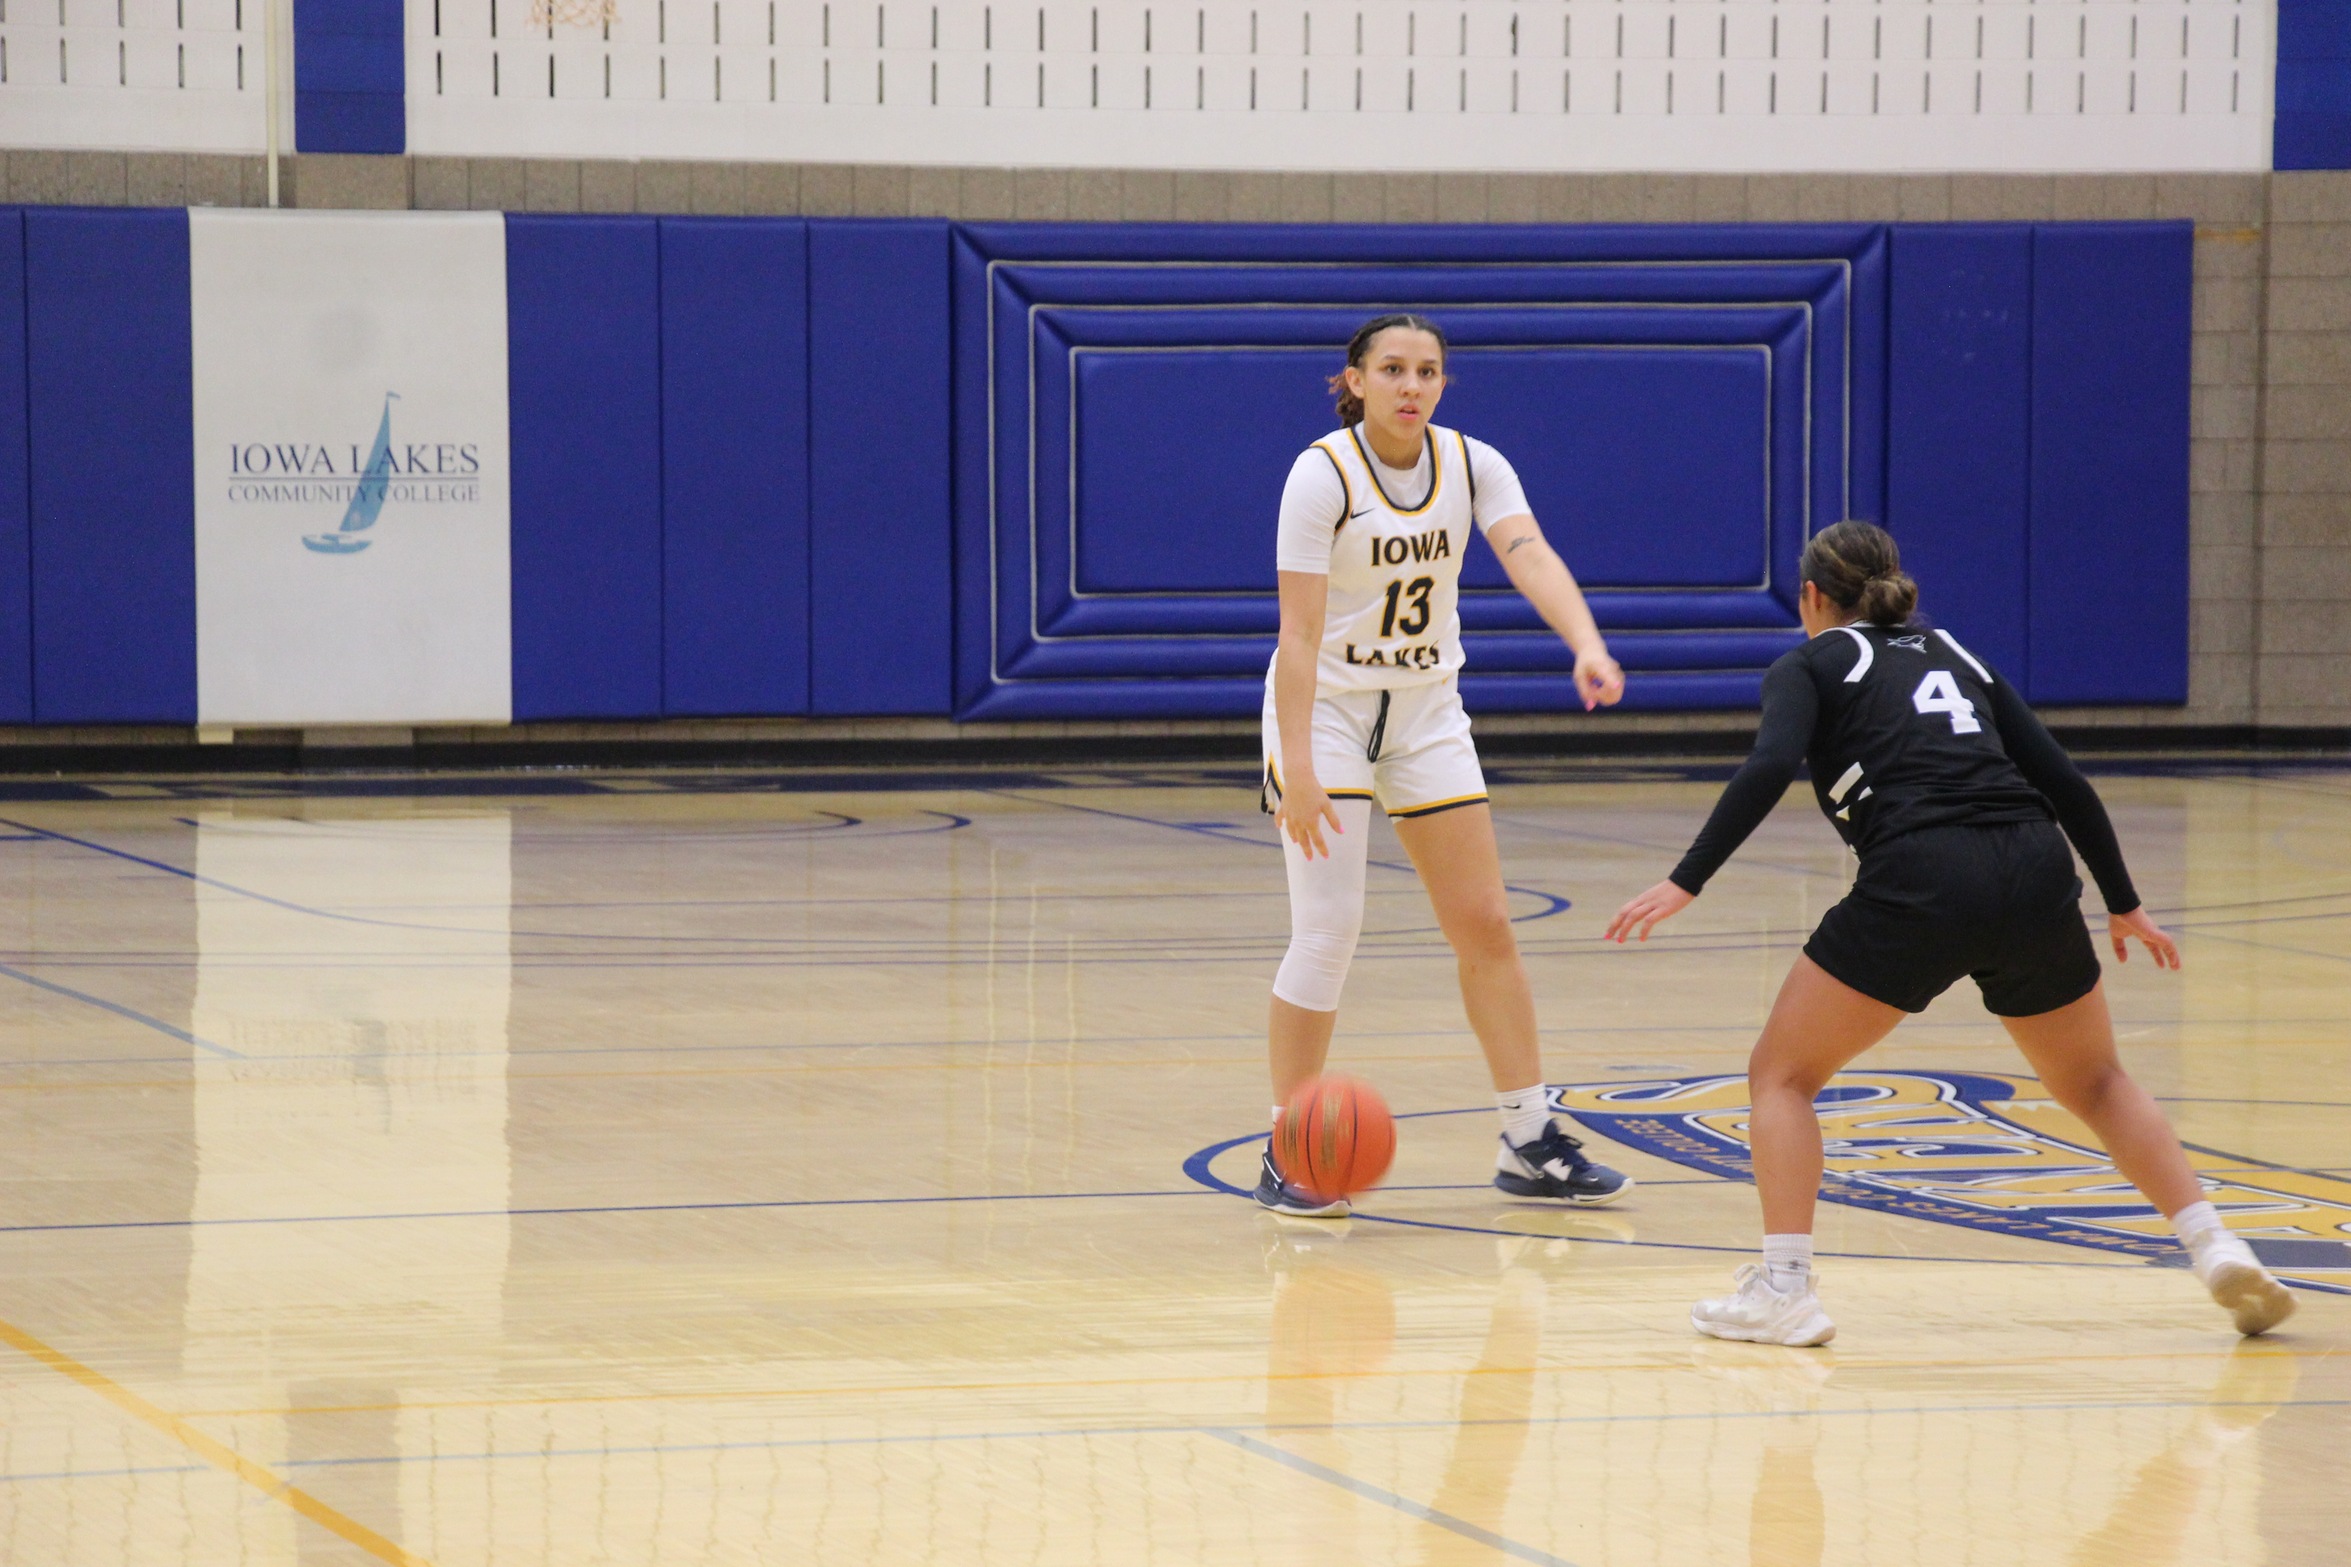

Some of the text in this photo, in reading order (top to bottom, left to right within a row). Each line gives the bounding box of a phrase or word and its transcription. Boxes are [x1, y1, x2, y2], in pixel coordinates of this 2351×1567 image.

[230, 443, 479, 474] IOWA LAKES
[228, 484, 480, 502] COMMUNITY COLLEGE
[1371, 529, 1451, 566] IOWA
[1379, 574, 1435, 638] 13
[1346, 642, 1440, 670] LAKES
[1912, 670, 1982, 734] 4
